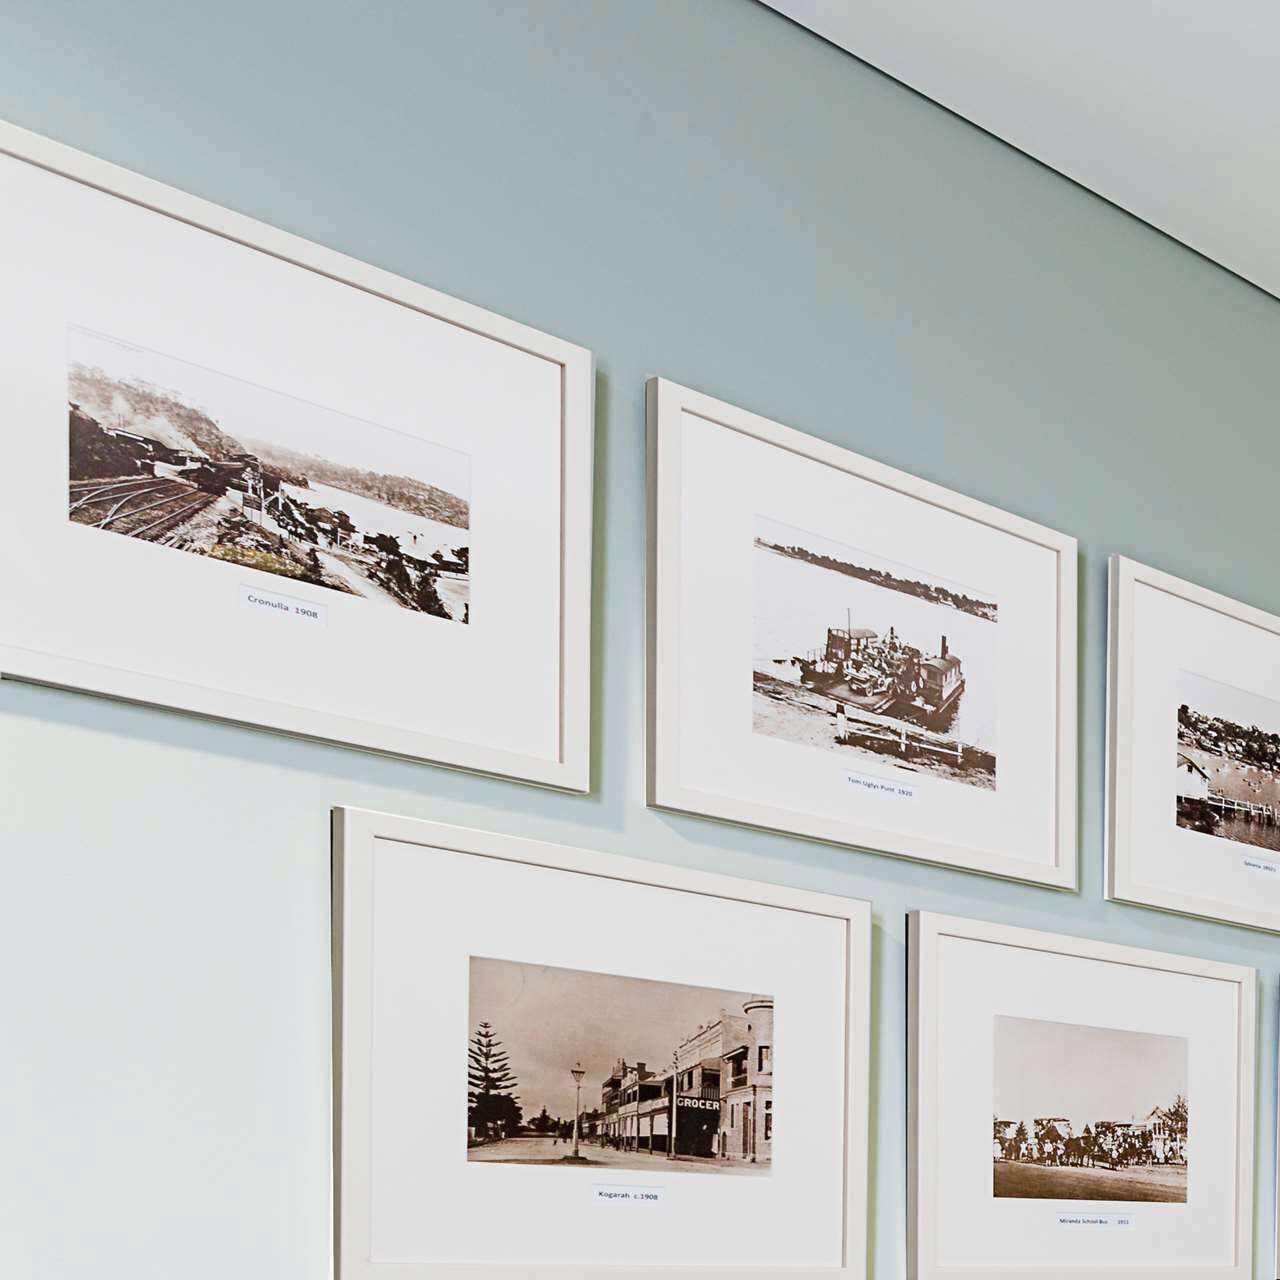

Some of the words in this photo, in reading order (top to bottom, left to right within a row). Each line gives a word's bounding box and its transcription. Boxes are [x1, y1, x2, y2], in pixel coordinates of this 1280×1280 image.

[247, 594, 289, 612] Cronulla
[295, 606, 318, 619] 1908
[848, 776, 862, 785] Tom
[677, 1097, 720, 1111] GROCER
[598, 1190, 630, 1199] Kogarah
